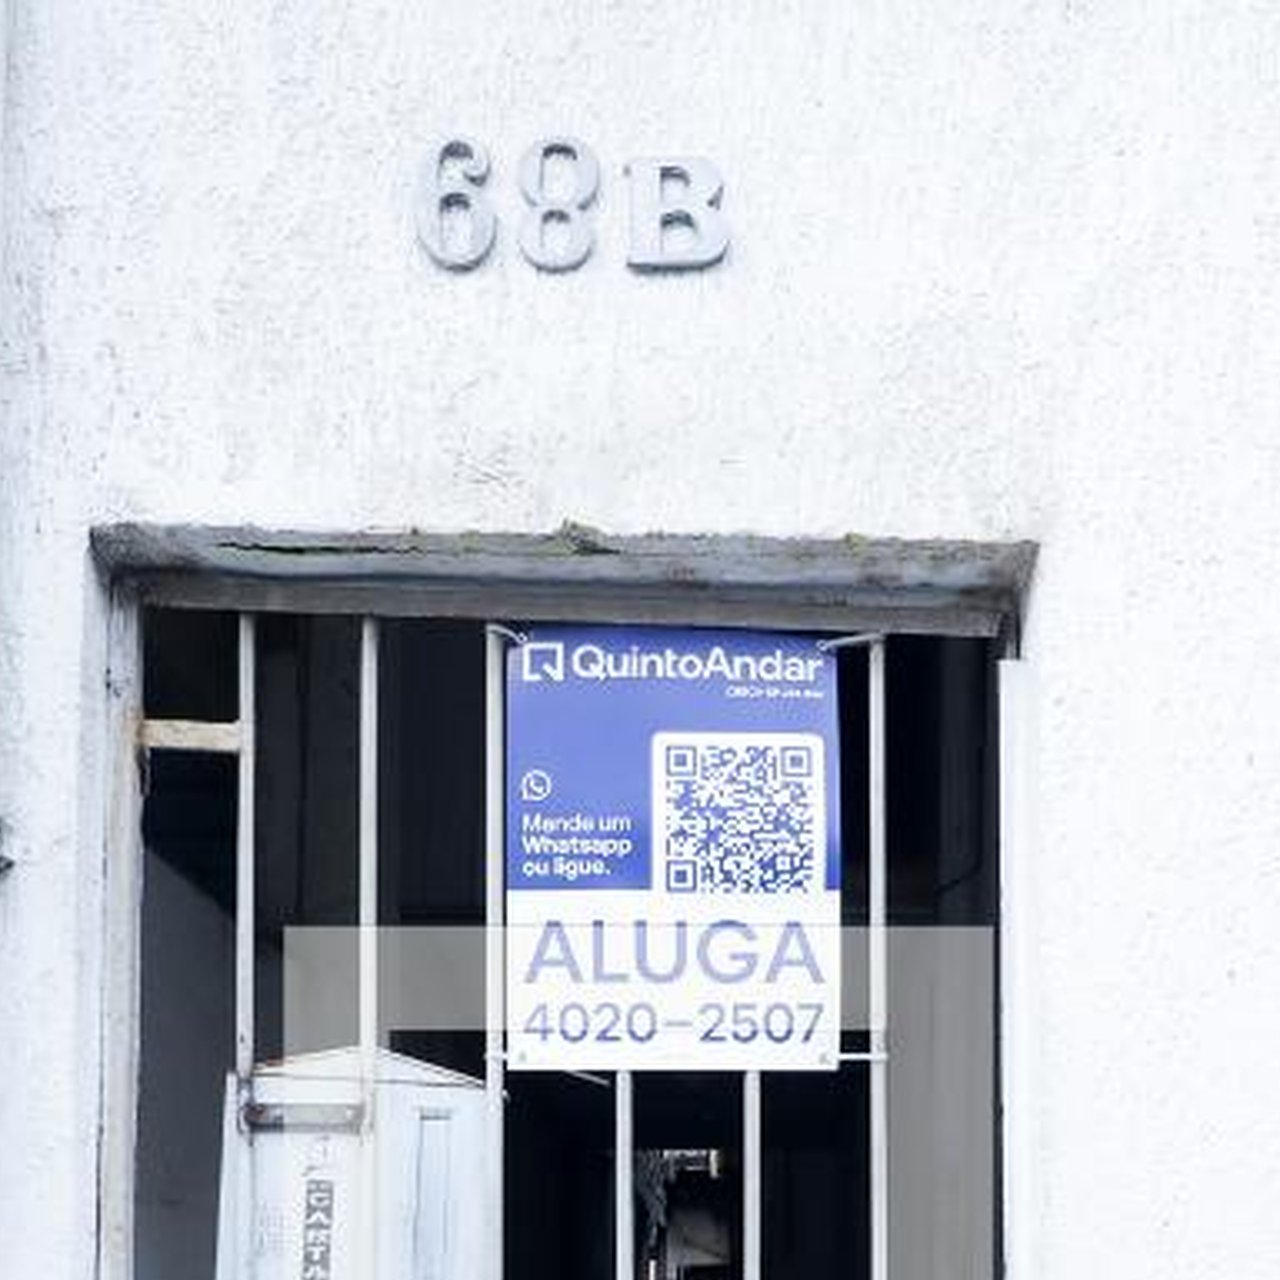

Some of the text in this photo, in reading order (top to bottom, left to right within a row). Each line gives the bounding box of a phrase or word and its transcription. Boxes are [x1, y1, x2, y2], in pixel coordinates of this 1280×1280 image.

[417, 138, 730, 275] 68B
[572, 643, 824, 682] QuintoAndar
[522, 813, 632, 832] Mande um
[521, 835, 633, 858] Whatsapp
[522, 856, 611, 881] ou ligue.
[523, 919, 826, 985] ALUGA
[523, 1002, 825, 1044] 4020-2507
